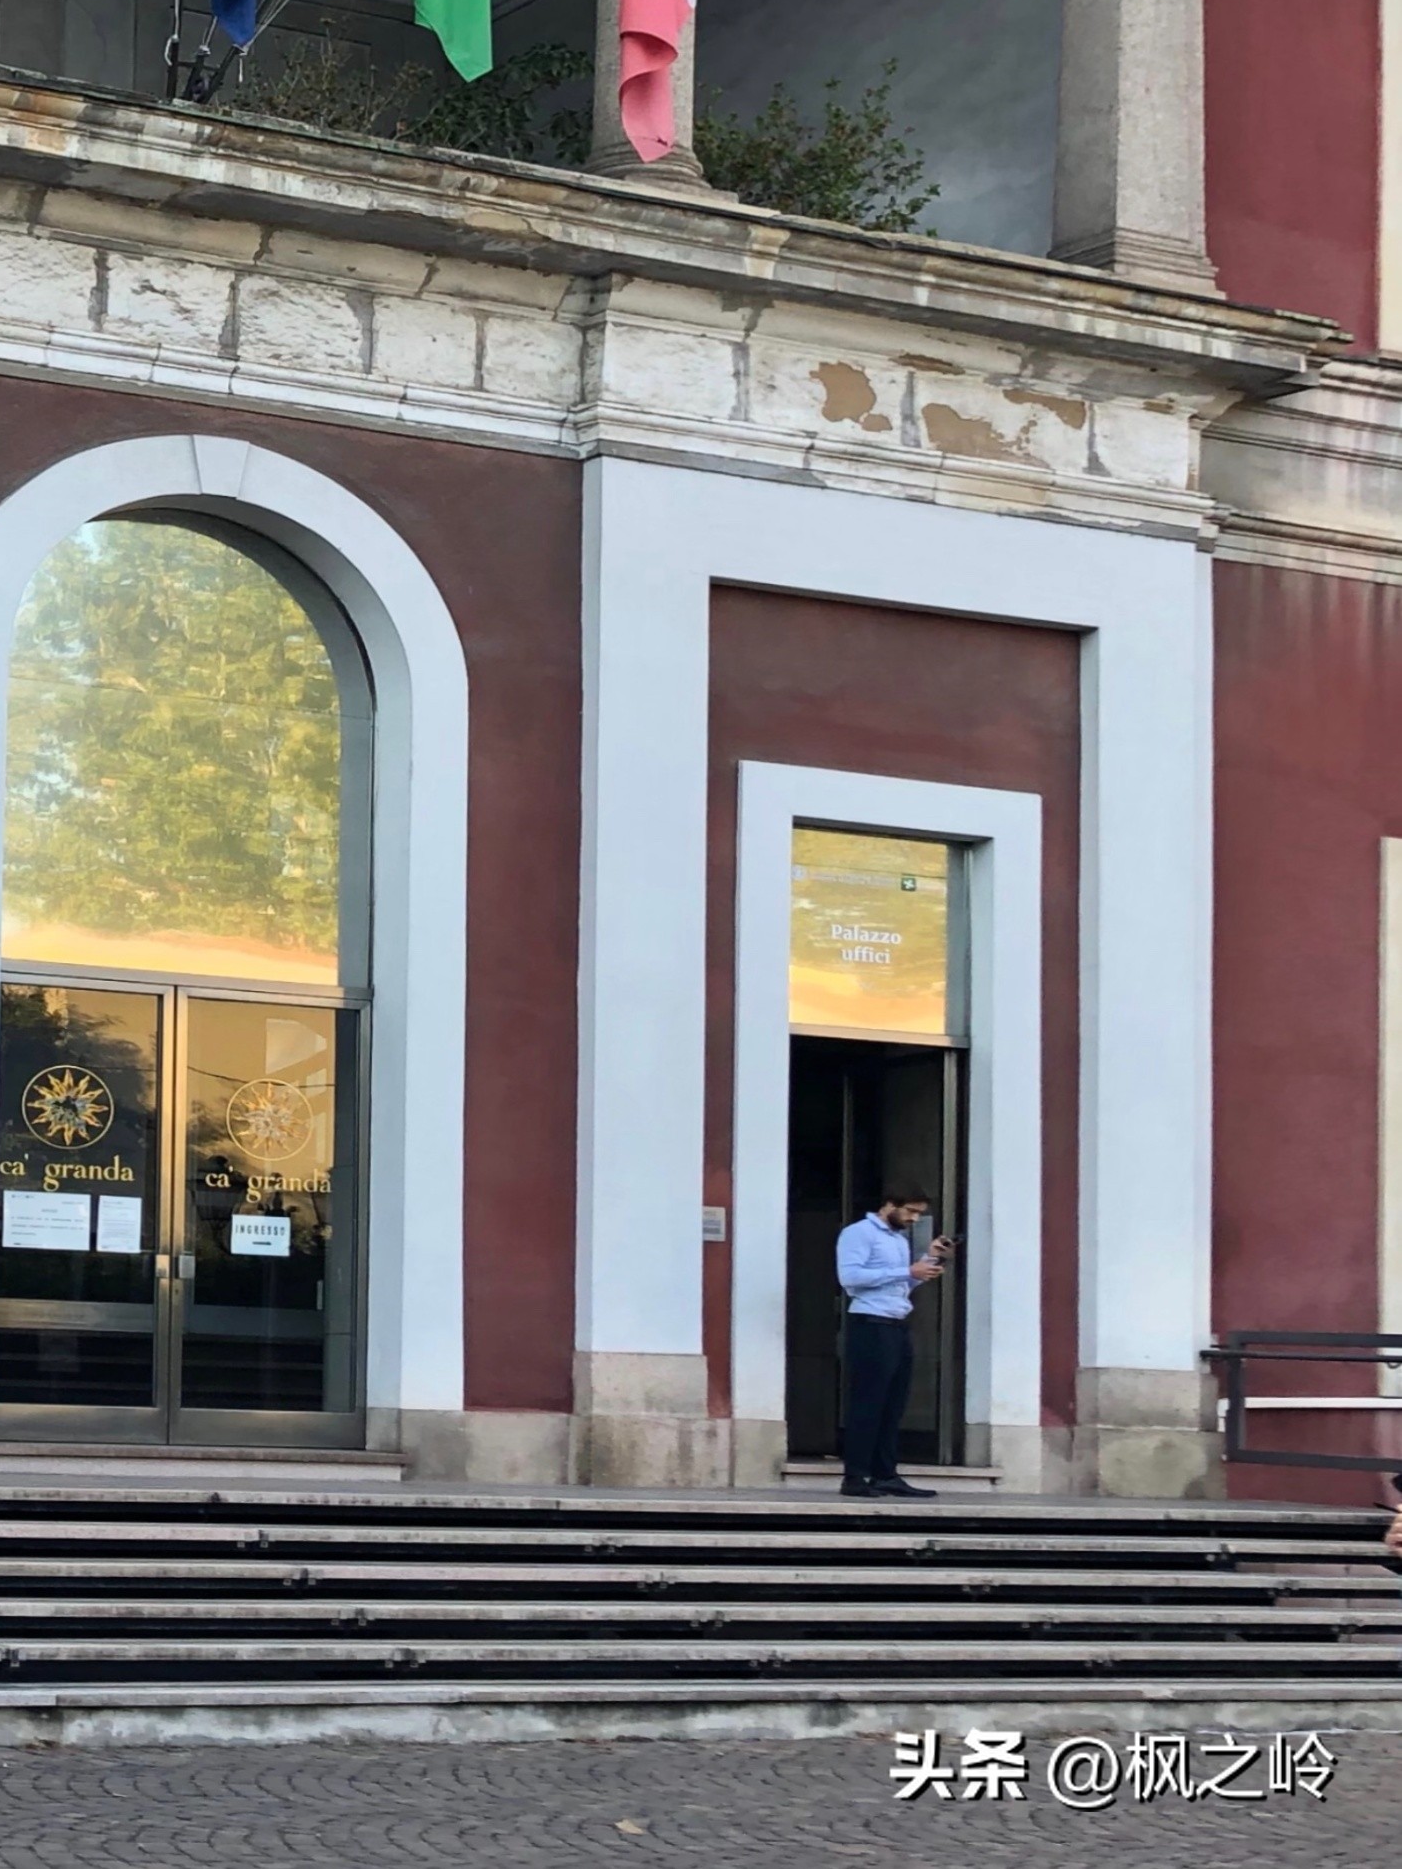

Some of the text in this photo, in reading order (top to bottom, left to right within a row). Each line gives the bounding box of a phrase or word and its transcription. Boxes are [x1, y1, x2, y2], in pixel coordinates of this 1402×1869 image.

[831, 924, 903, 945] Palazzo
[841, 946, 891, 964] uffici
[43, 1154, 135, 1192] granda
[246, 1168, 332, 1203] granda
[235, 1224, 285, 1236] INGRESSO
